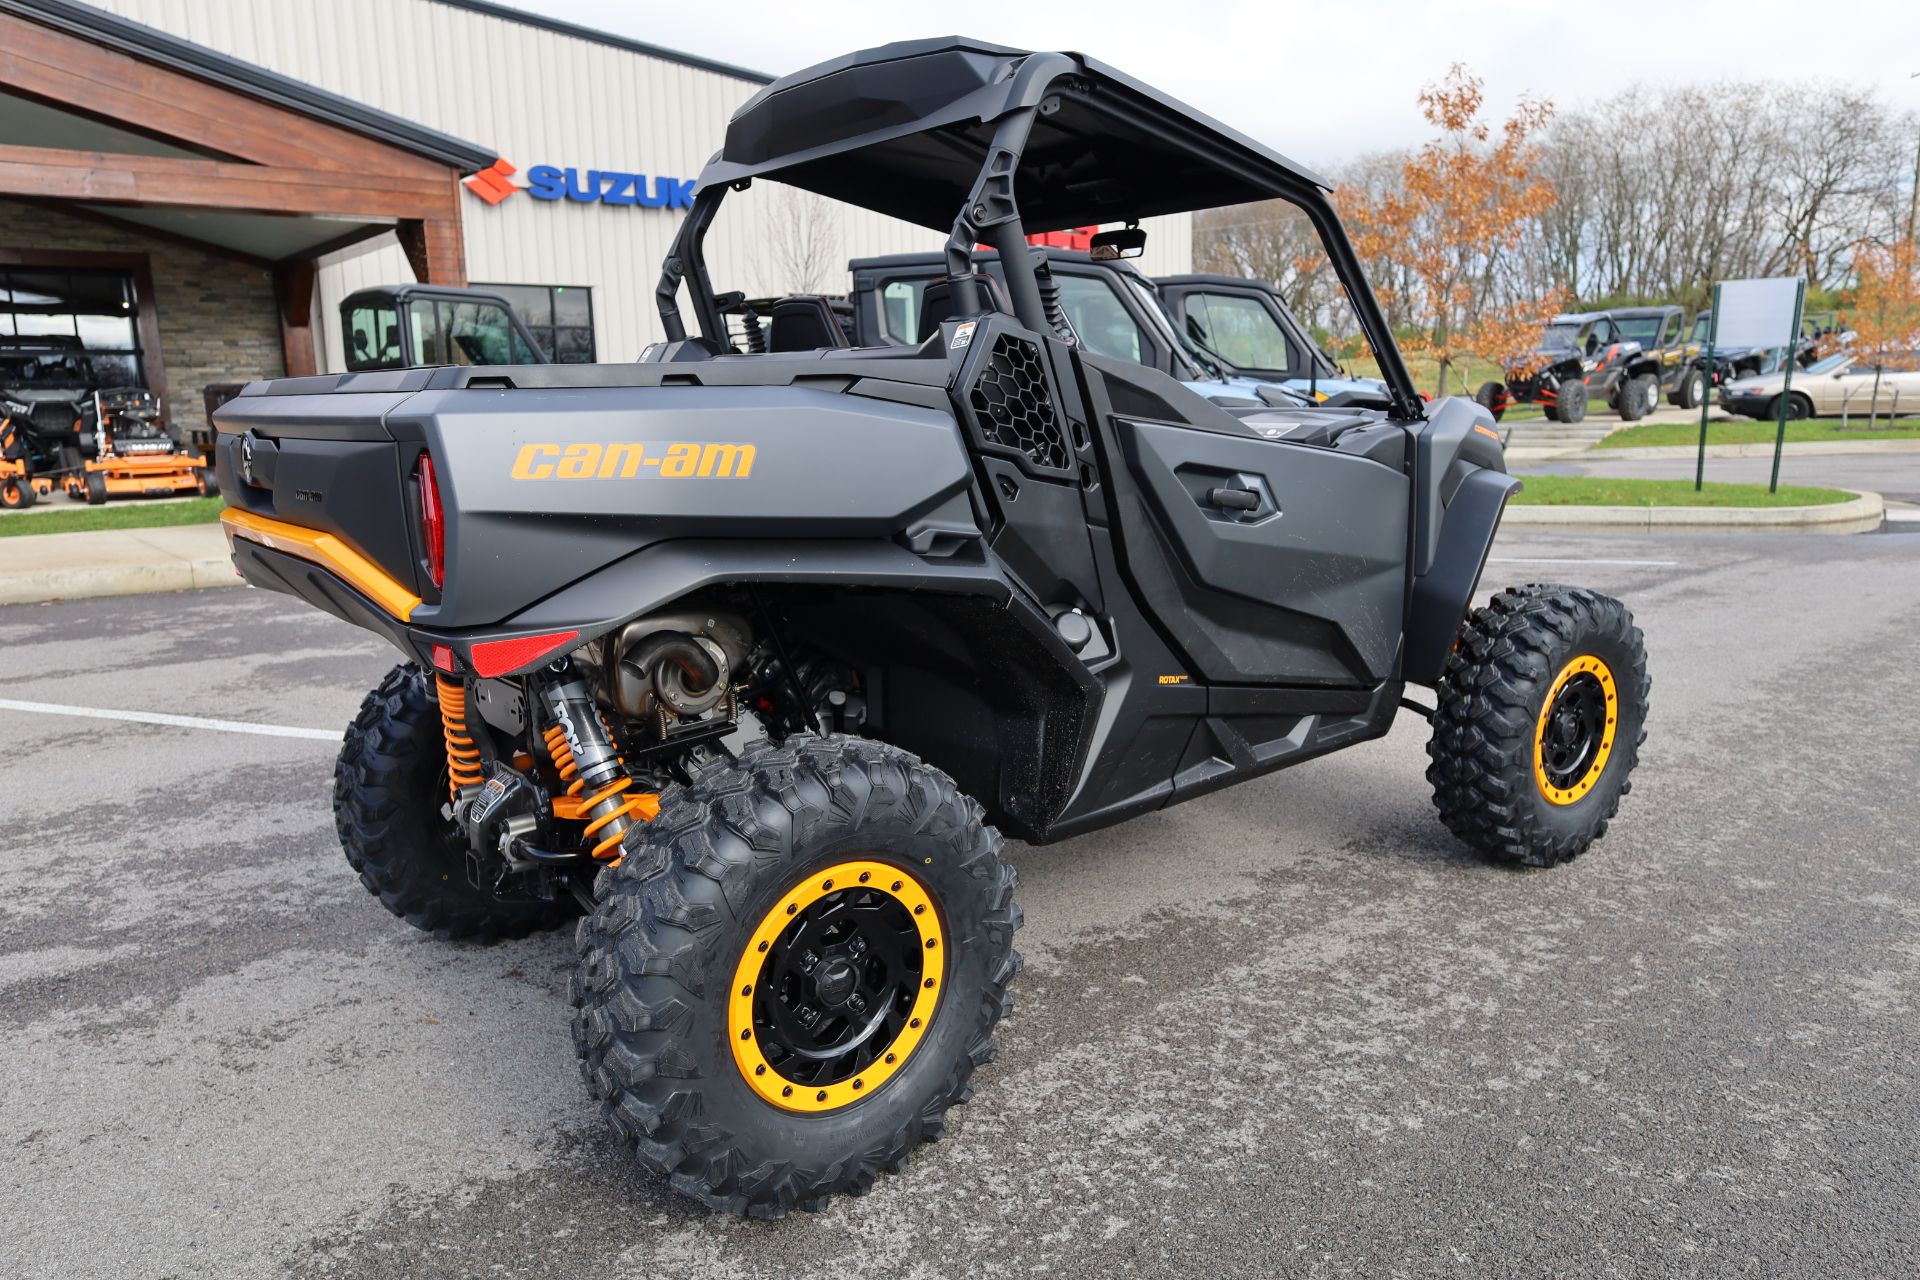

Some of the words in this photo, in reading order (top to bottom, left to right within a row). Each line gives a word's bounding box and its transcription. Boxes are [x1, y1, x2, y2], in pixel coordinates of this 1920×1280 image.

[527, 165, 697, 209] SUZUK
[511, 443, 756, 479] can-am
[1158, 675, 1180, 684] ROTAX
